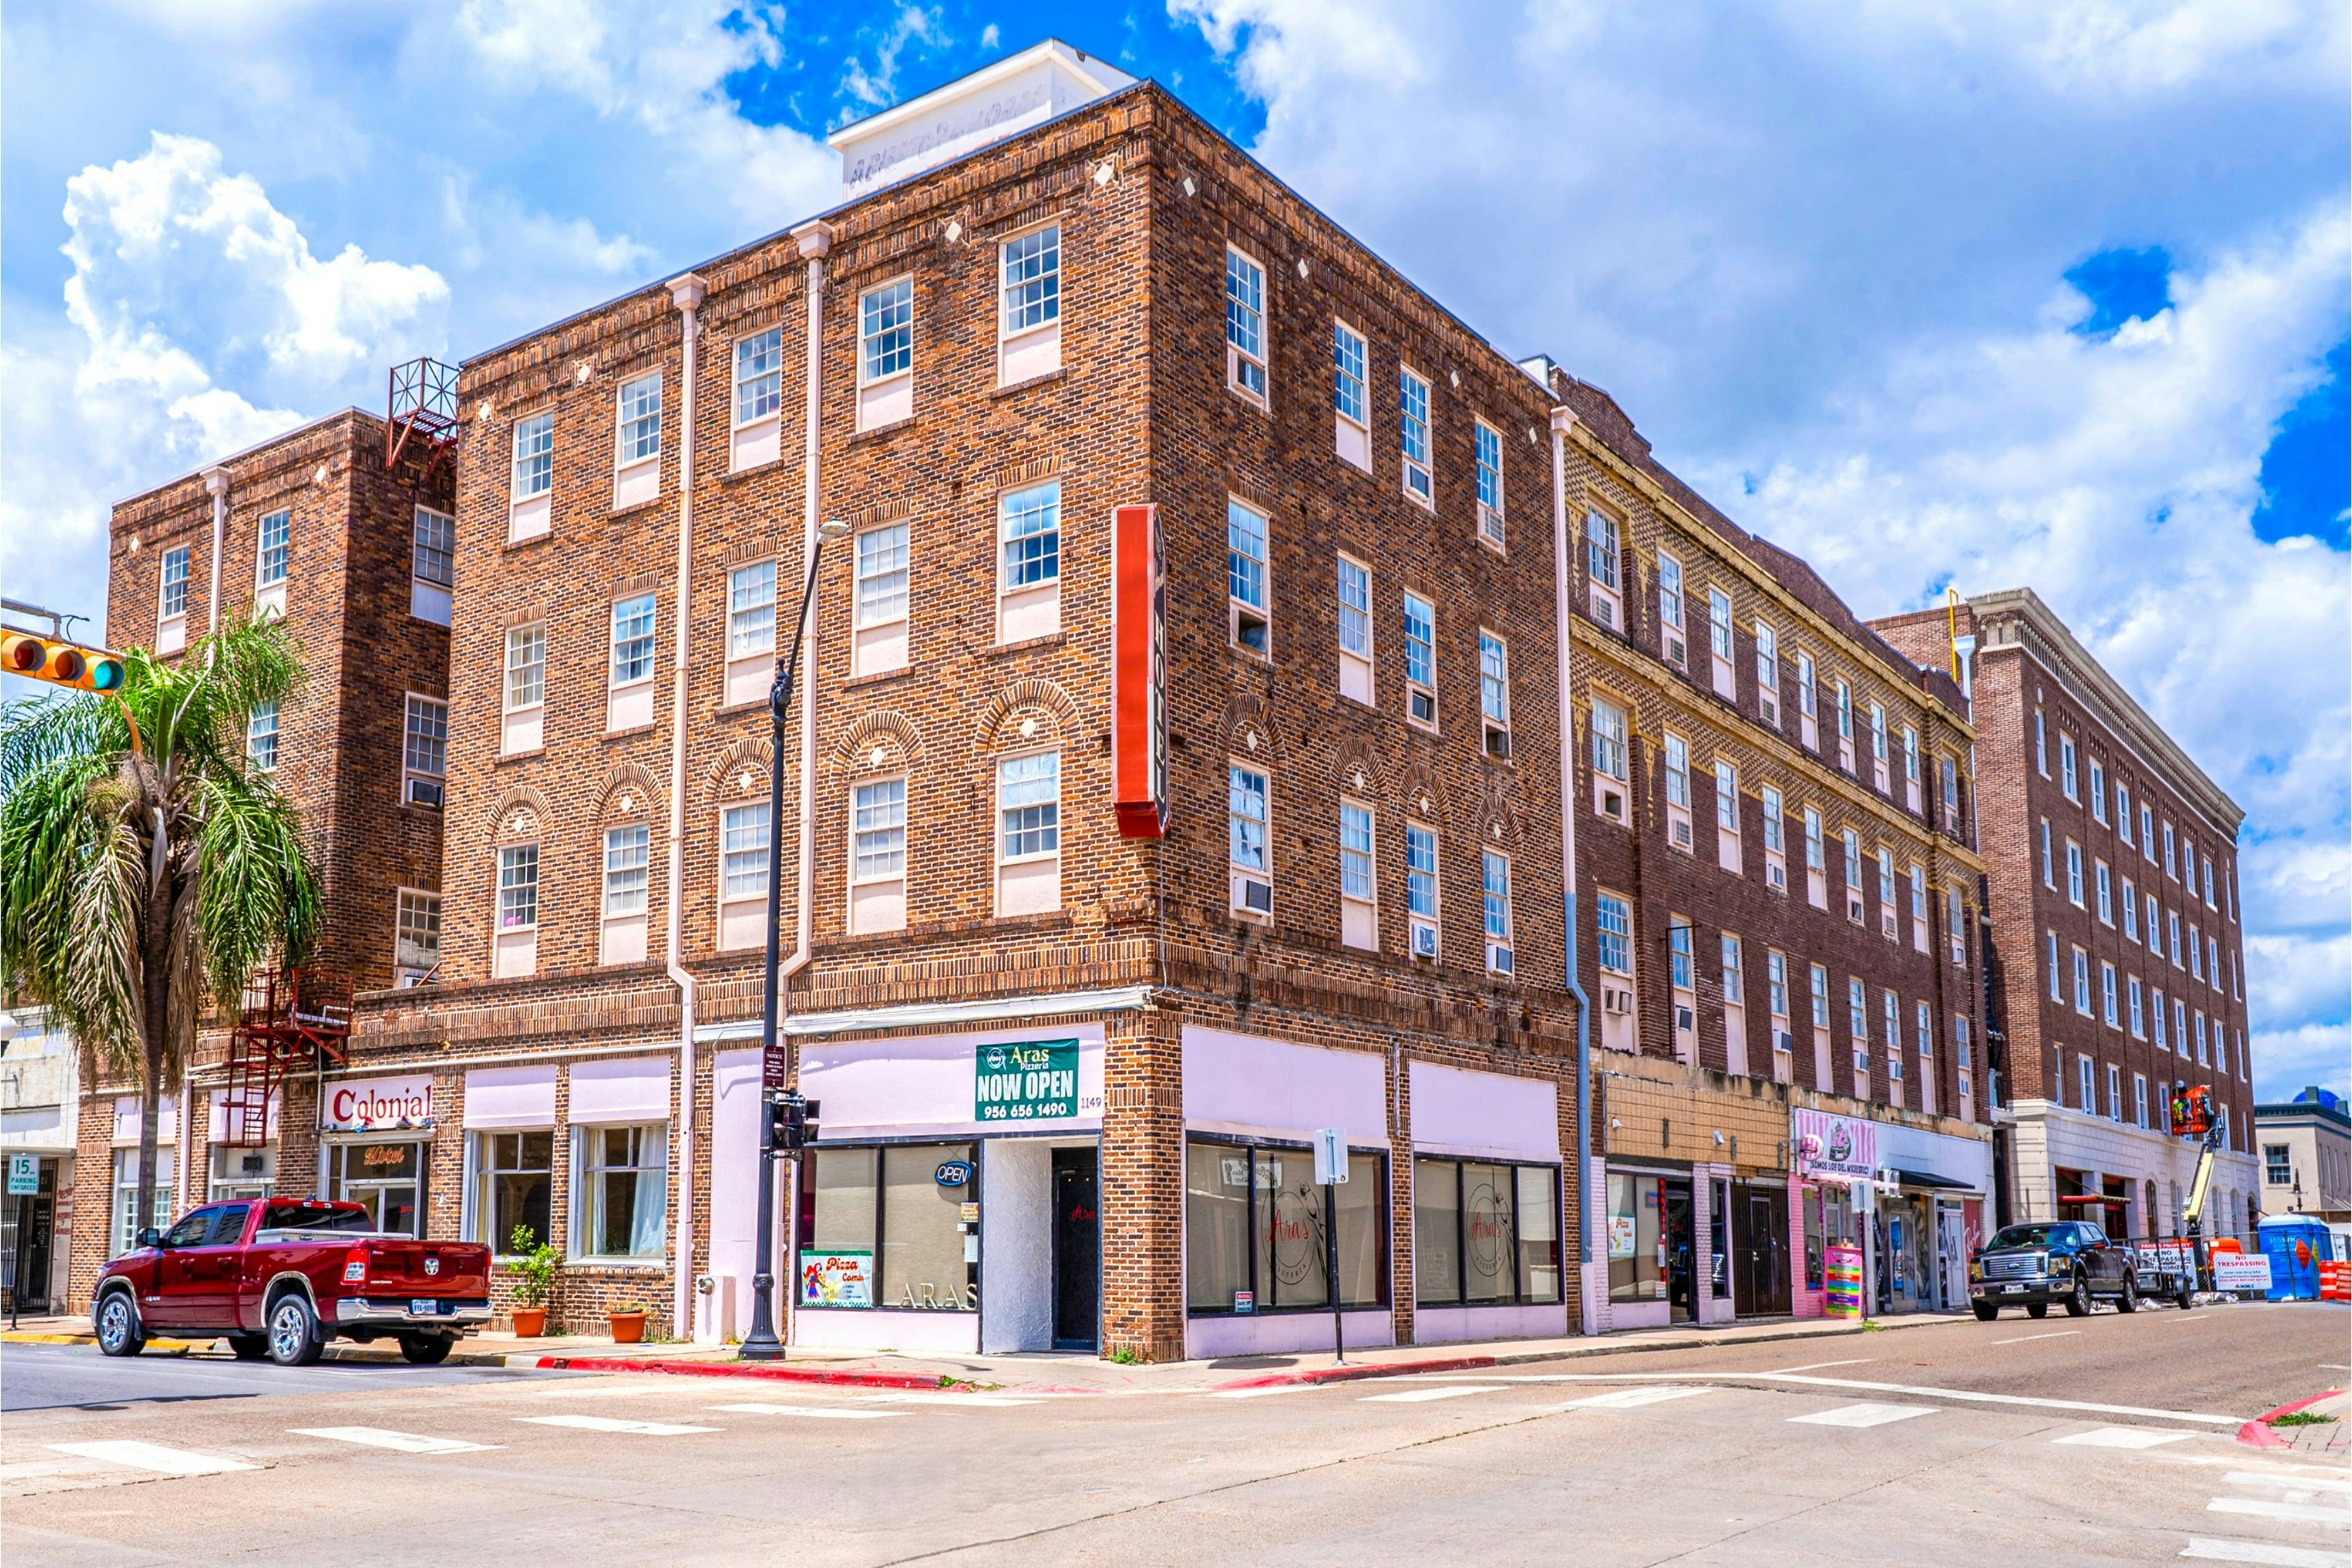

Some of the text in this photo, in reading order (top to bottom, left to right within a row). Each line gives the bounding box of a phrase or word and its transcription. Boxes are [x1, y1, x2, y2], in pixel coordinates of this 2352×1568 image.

[1154, 610, 1165, 804] HOTEL
[1010, 1046, 1049, 1064] Aras
[1020, 1061, 1049, 1071] Pizzeria
[977, 1070, 1073, 1102] NOW OPEN
[333, 1084, 431, 1122] Colonial
[984, 1102, 1067, 1119] 956 656 1490
[1081, 1096, 1102, 1109] 1149
[363, 1145, 405, 1165] Hotel
[16, 1159, 30, 1175] 15
[937, 1165, 968, 1183] OPEN
[826, 1257, 858, 1271] Pizza
[900, 1282, 978, 1311] ARAS
